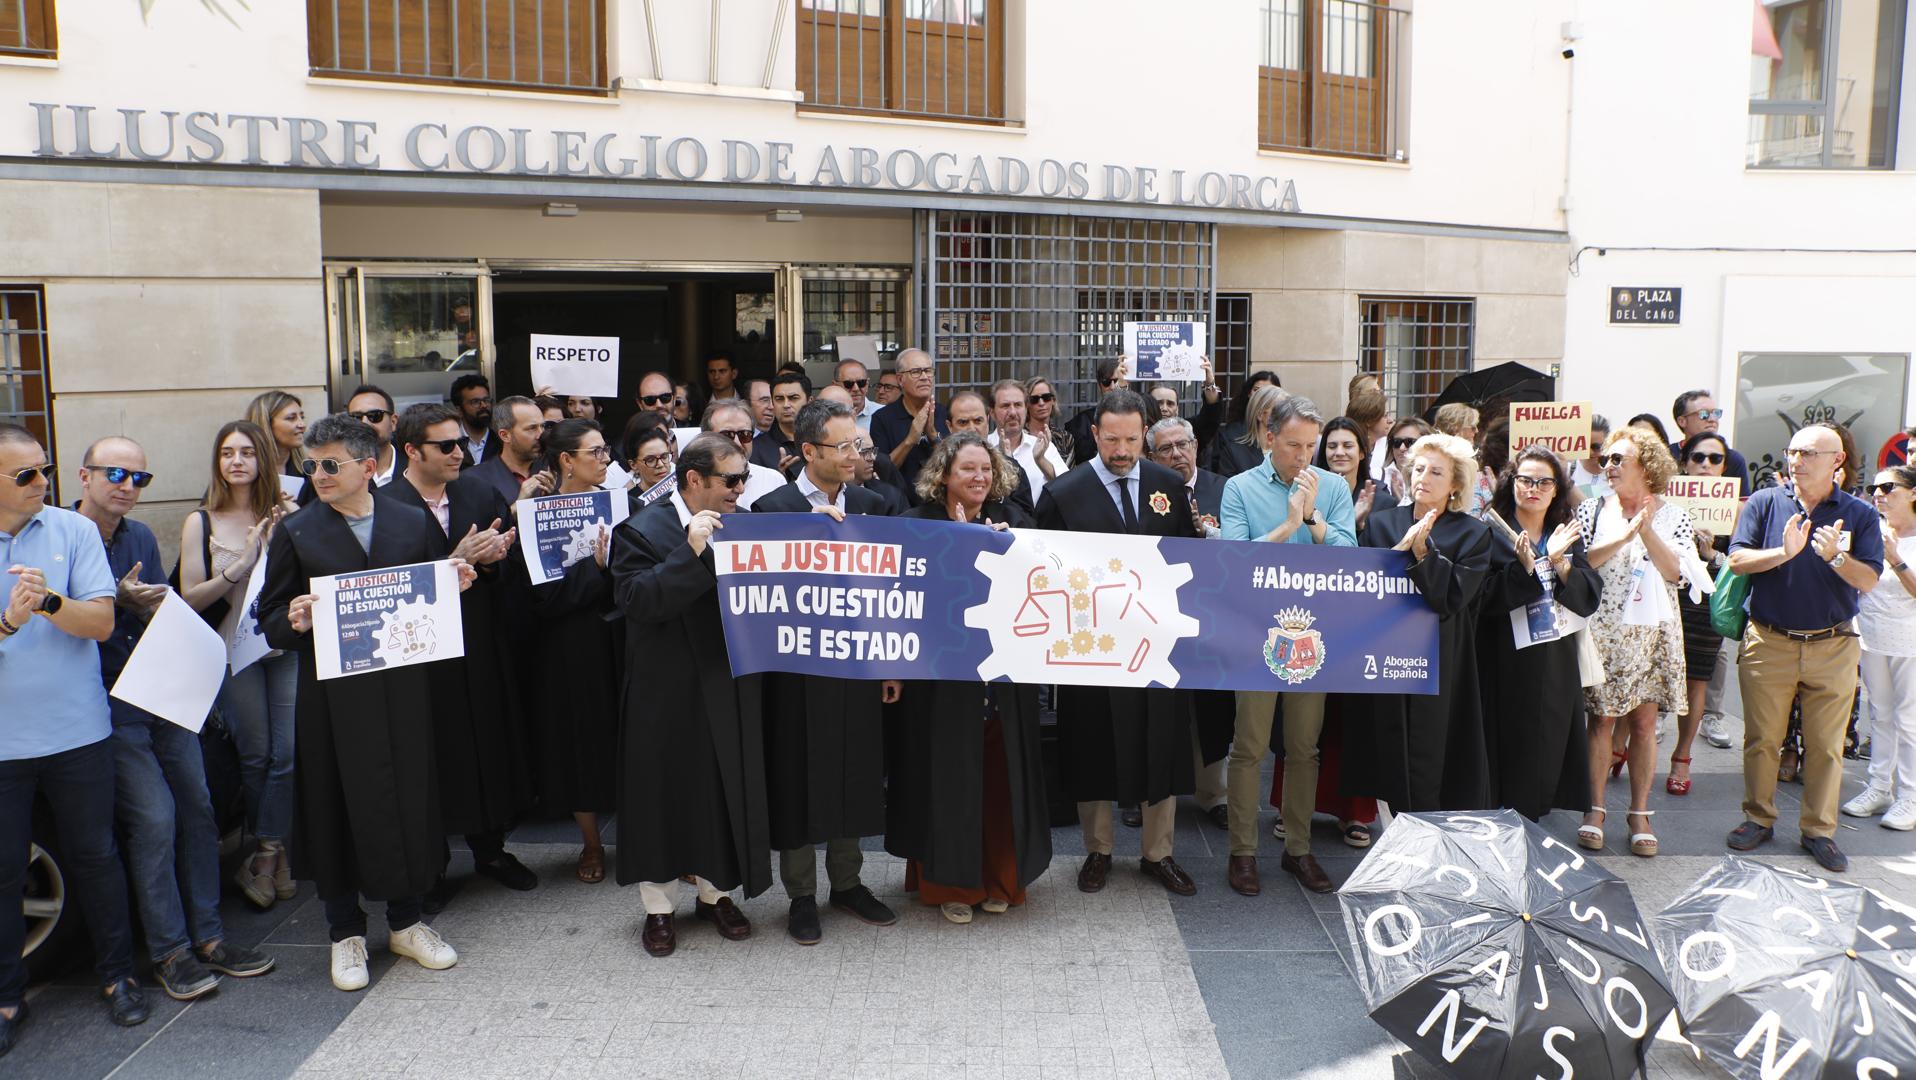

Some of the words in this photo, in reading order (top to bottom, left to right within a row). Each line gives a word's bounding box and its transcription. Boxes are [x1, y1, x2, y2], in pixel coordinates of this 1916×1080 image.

[29, 102, 380, 169] ILUSTRE
[405, 123, 708, 181] COLEGIO
[722, 139, 797, 185] DE
[809, 145, 1090, 200] ABOGADOS
[1101, 164, 1159, 203] DE
[1171, 170, 1302, 213] LORCA
[1637, 290, 1672, 303] PLAZA
[1616, 309, 1637, 320] DEL
[1645, 308, 1674, 320] CAÑO
[536, 346, 611, 362] RESPETO
[1515, 405, 1580, 421] HUELGA
[1665, 481, 1734, 498] HUELGA
[536, 502, 547, 510] LA
[548, 498, 583, 510] JUSTICIA
[584, 496, 593, 506] ES
[537, 511, 554, 521] UNA
[1688, 507, 1733, 522] STICIA
[538, 521, 549, 531] DE
[550, 519, 581, 530] ESTADO
[732, 544, 767, 571] LA
[781, 542, 898, 575] JUSTICIA
[905, 557, 927, 577] ES
[339, 579, 351, 590] LA
[353, 573, 397, 588] JUSTICIA
[399, 571, 411, 583] ES
[1252, 566, 1422, 600] #Abogacía28juni
[338, 590, 361, 603] UNA
[729, 585, 789, 616] UNA
[796, 582, 925, 619] CUESTIÓN
[339, 603, 354, 615] DE
[355, 598, 395, 612] ESTADO
[777, 626, 812, 656] DE
[819, 630, 920, 662] ESTADO
[1383, 655, 1428, 669] Abogacía
[1382, 667, 1428, 680] Española
